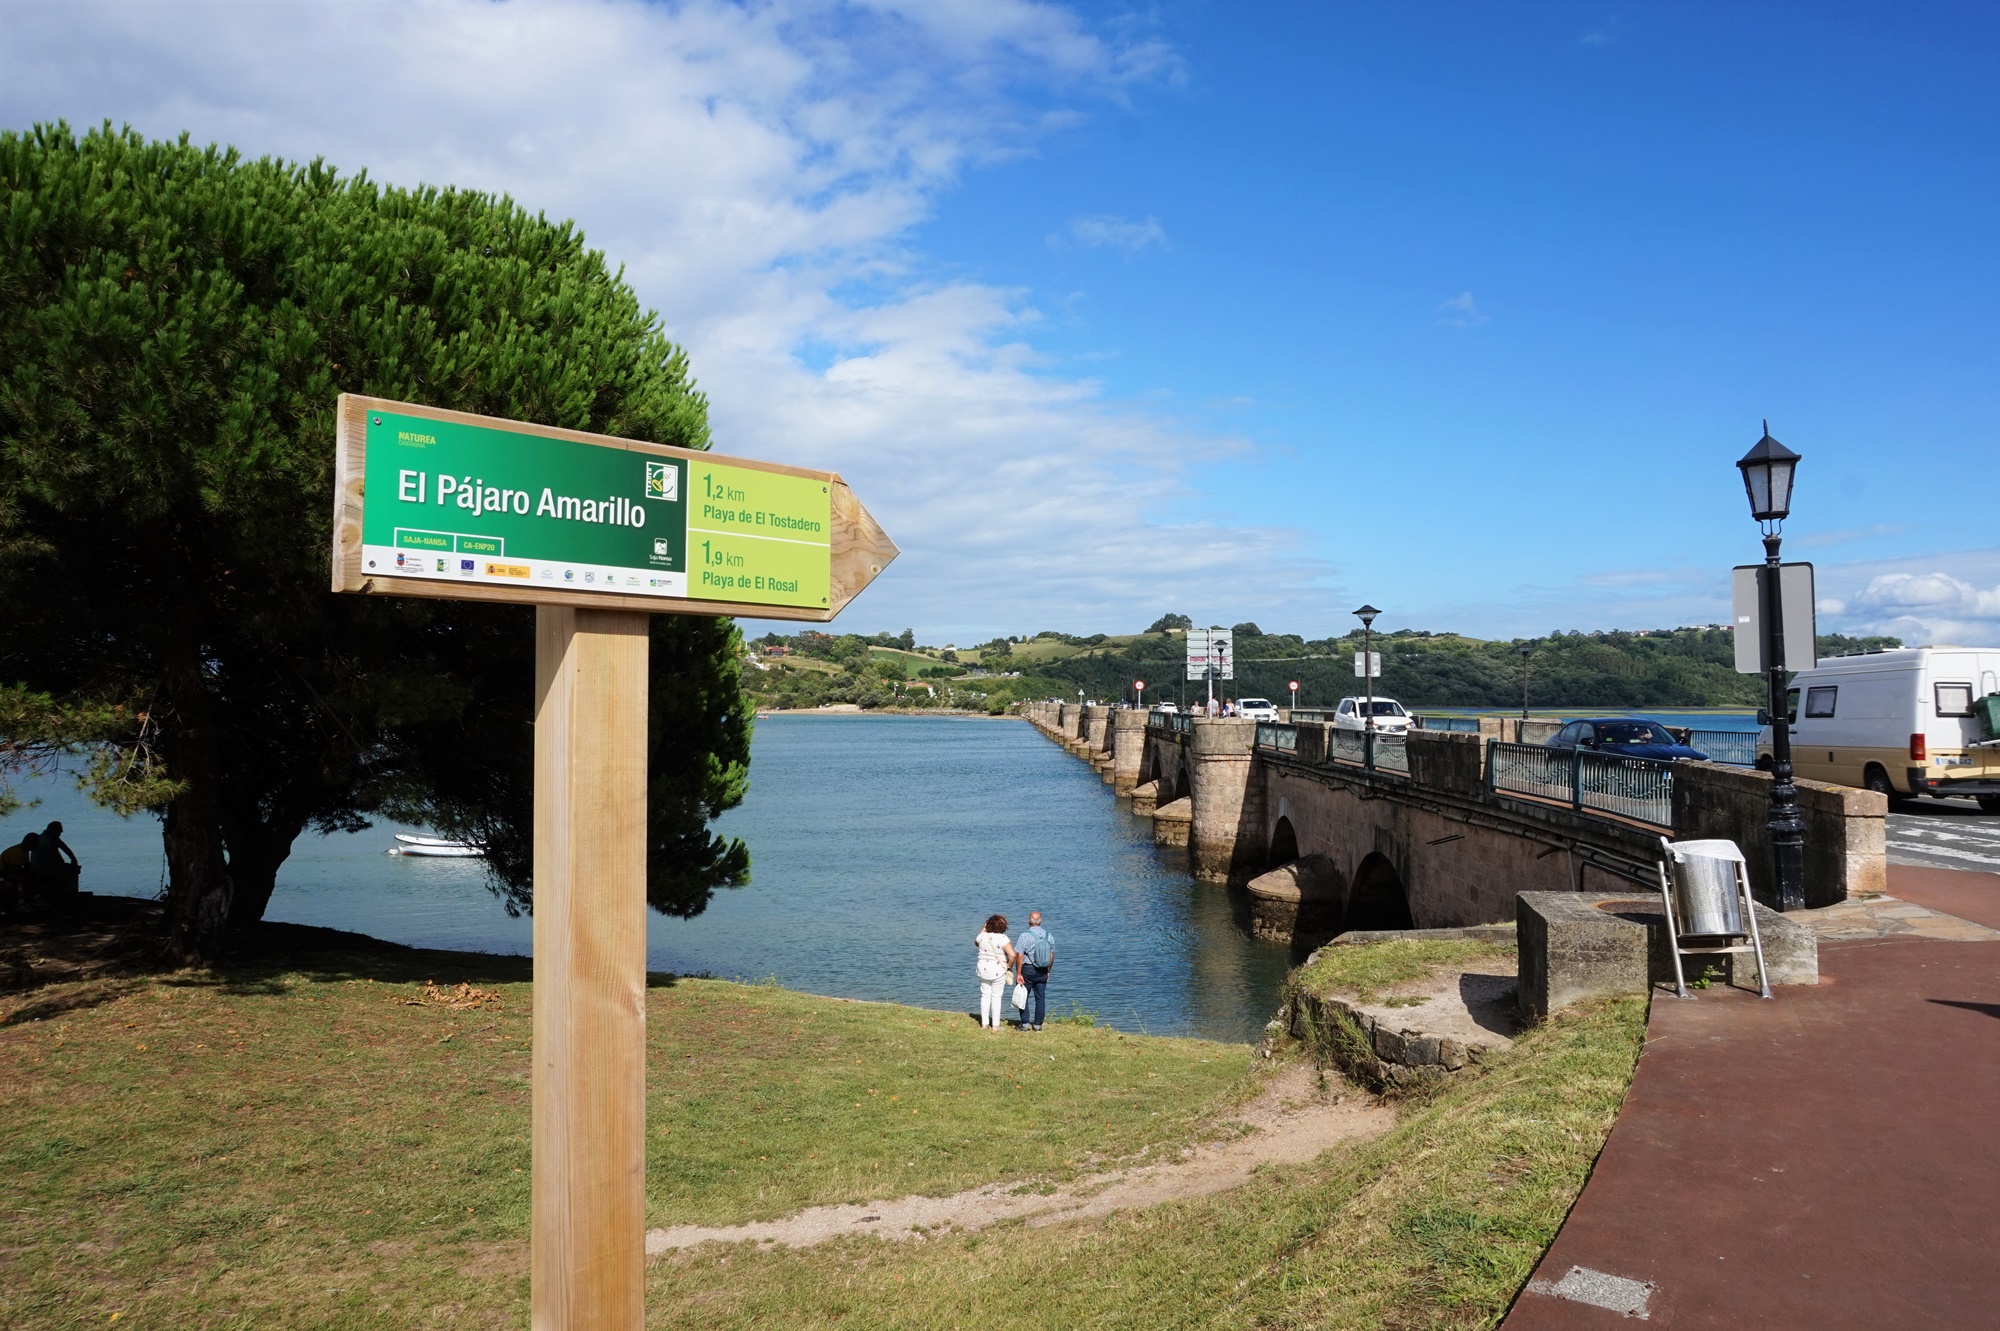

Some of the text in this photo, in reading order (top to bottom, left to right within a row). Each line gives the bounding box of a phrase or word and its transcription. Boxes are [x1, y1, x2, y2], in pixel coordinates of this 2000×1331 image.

[398, 431, 436, 445] NATUREA
[398, 469, 646, 528] El Pájaro Amarillo
[703, 473, 745, 502] 1,2 km
[703, 504, 821, 533] Playa de El Tostadero
[403, 535, 448, 547] SAJA-NANSA
[463, 541, 495, 552] CA-ENP20
[702, 539, 744, 567] 1,9 km
[702, 571, 799, 593] Playa de El Rosal
